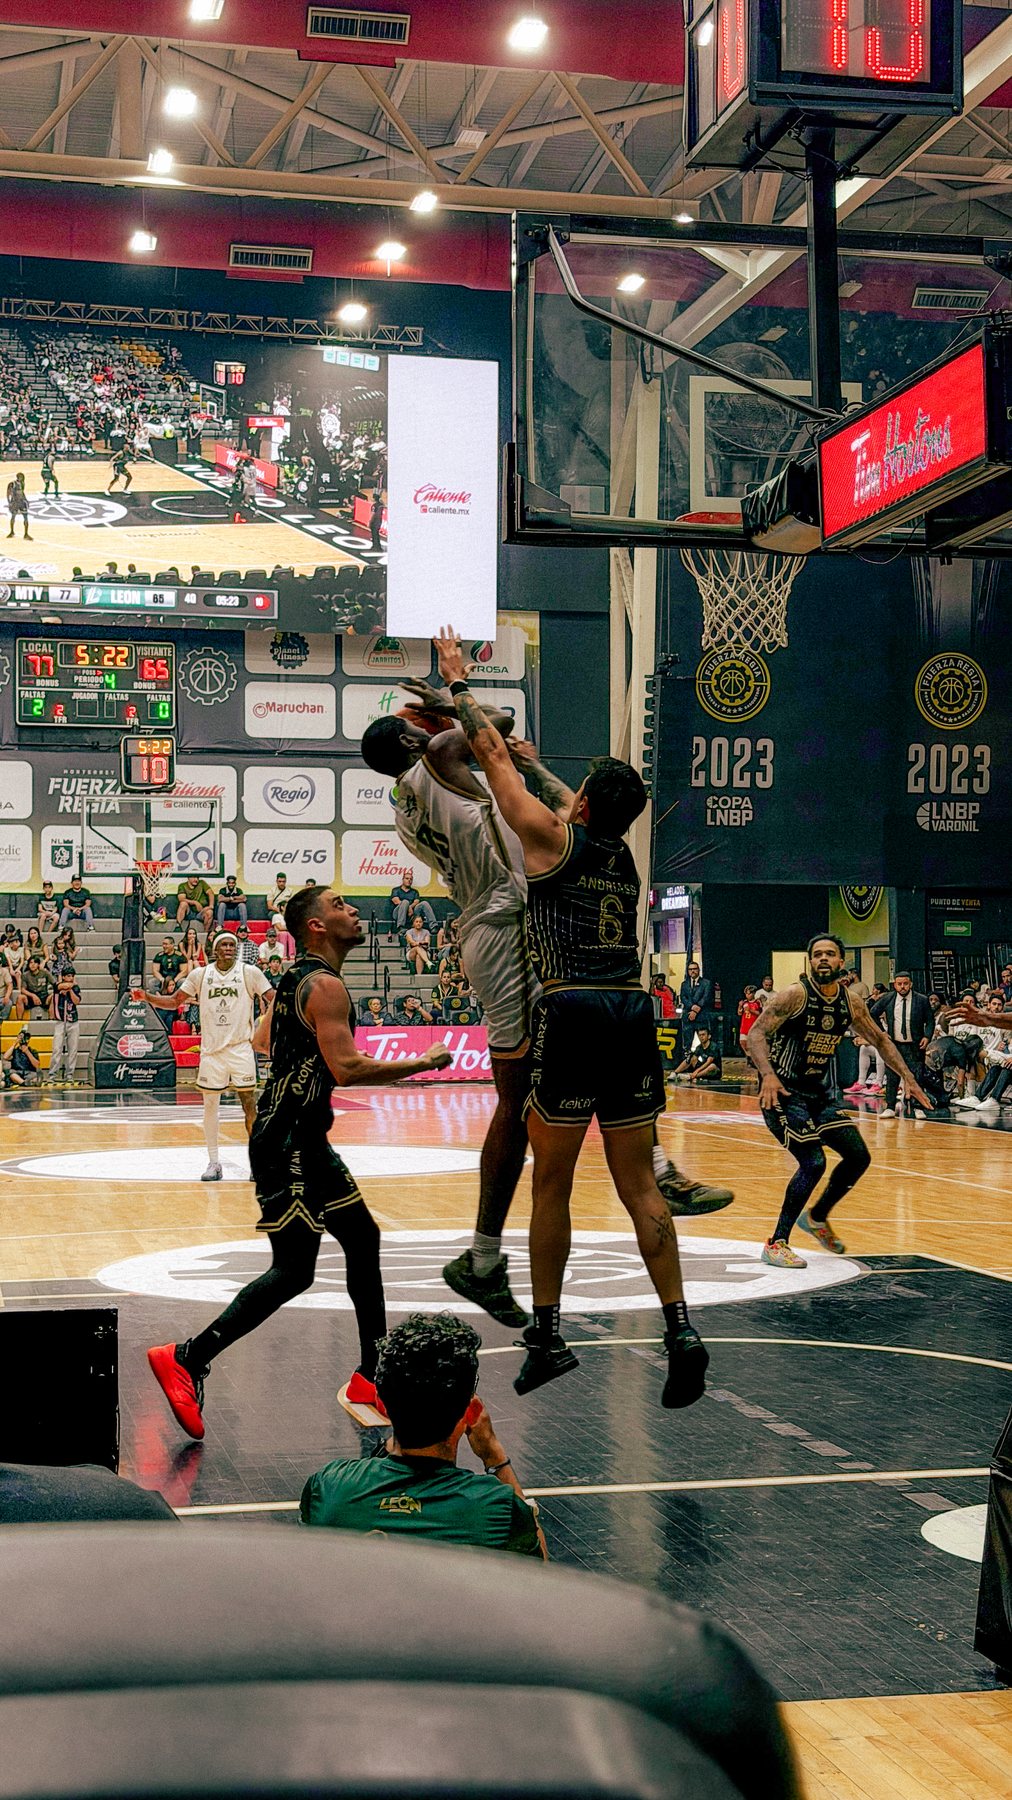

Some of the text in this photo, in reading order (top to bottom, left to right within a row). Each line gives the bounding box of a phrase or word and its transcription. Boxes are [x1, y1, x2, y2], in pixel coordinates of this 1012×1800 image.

[851, 408, 952, 507] Tim Hortons
[413, 483, 472, 505] Caliente
[428, 506, 470, 516] caliente.mx
[14, 586, 44, 600] MTY
[59, 590, 72, 600] 77
[216, 595, 240, 607] 05:23
[23, 643, 54, 653] LOCAL
[76, 645, 129, 666] 5:22
[137, 648, 173, 659] VISITANTE
[274, 647, 301, 656] planet
[27, 655, 54, 677] 77
[143, 658, 170, 681] 65
[705, 652, 761, 677] FUERZA REGIA
[923, 658, 980, 687] FUERZA REGIA
[36, 680, 60, 689] BONUS
[74, 676, 105, 684] PERIODO
[105, 673, 116, 689] 4
[133, 684, 156, 692] BONUS
[21, 691, 46, 699] FALTAS
[72, 692, 99, 700] JUGADOR
[146, 694, 171, 702] FALTAS
[33, 699, 44, 716] 2
[54, 704, 65, 717] 2
[159, 702, 170, 719] 0
[266, 702, 325, 714] Maruchan
[138, 740, 171, 755] 5:22
[141, 756, 168, 784] 10
[691, 736, 775, 789] 2023
[907, 743, 991, 794] 2023
[48, 777, 122, 796] FUERZ
[172, 780, 225, 797] aliente
[270, 786, 310, 803] Regio
[357, 786, 384, 799] red
[58, 796, 120, 813] REGIA
[705, 796, 752, 809] COPA
[706, 809, 753, 827] LNBP
[932, 802, 980, 820] LNBP
[931, 819, 980, 832] VARONIL
[251, 848, 327, 864] telcel 5G
[372, 840, 399, 857] Tim
[358, 858, 413, 877] Hortons
[930, 898, 981, 907] PUNTO DE VENTA
[806, 1014, 816, 1026] 12
[804, 1031, 842, 1045] FUERZA
[807, 1042, 836, 1055] REGIA
